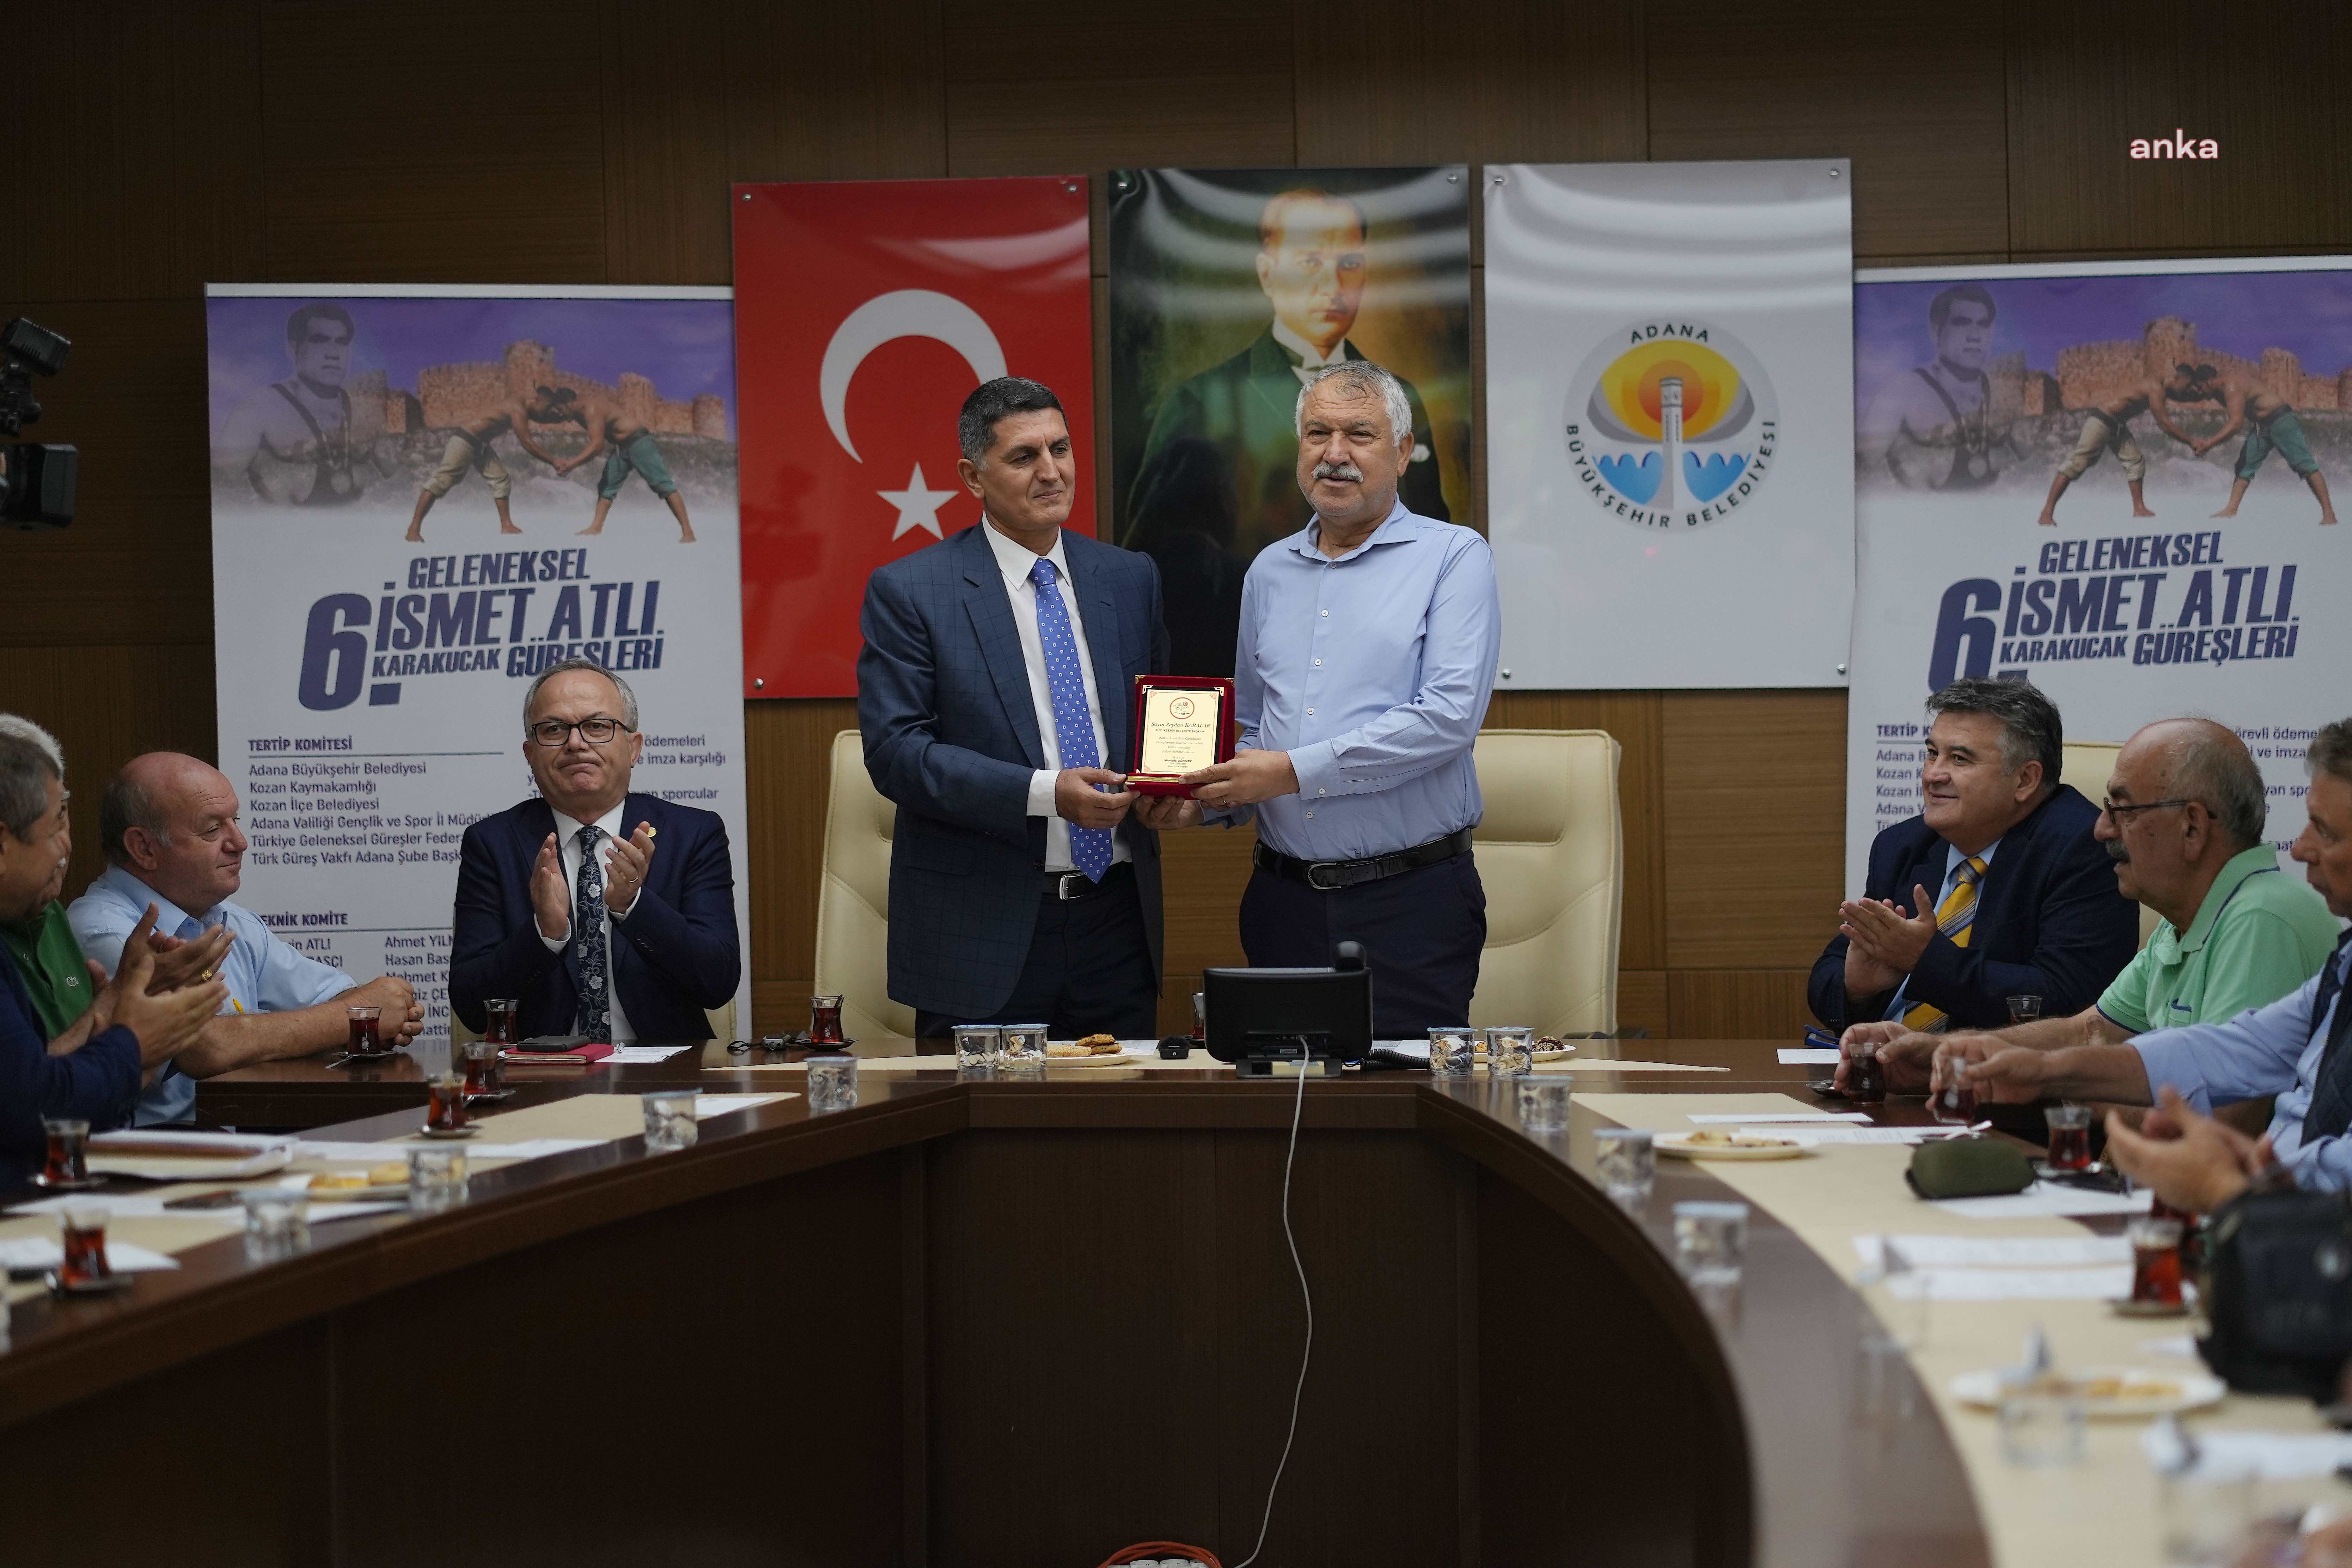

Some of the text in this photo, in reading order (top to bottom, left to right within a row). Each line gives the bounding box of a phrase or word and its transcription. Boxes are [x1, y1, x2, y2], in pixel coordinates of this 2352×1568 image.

[1631, 324, 1708, 343] ADANA
[2039, 531, 2223, 574] GELENEKSEL
[407, 548, 591, 590] GELENEKSEL
[2003, 565, 2297, 637] İSMET ATLI
[375, 580, 660, 652] İSMET ATLI
[1999, 616, 2299, 666] KARAKUCAK GÜREŞLERİ
[372, 648, 500, 678] KARAKUCAK
[1876, 722, 1918, 737] TERTİP
[249, 736, 352, 751] TERTİP KOMİTESİ
[645, 735, 705, 748] ödemeleri
[648, 752, 676, 765] imza
[680, 751, 726, 767] karşılığı
[1876, 750, 1914, 762] Adana
[2257, 748, 2271, 758] ve
[2275, 745, 2306, 758] imza
[250, 762, 427, 777] Adana Büyükşehir Belediyesi
[1876, 767, 1912, 779] Kozan
[250, 780, 377, 795] Kozan Kaymakamlığı
[662, 787, 719, 801] sporcular
[1876, 785, 1912, 797] Kozan
[251, 796, 379, 813] Kozan İlçe Belediyesi
[1875, 802, 1913, 815] Adana
[251, 817, 289, 830] Adana
[294, 815, 334, 830] Valiliği
[338, 815, 384, 829] Gençlik
[387, 818, 402, 826] ve
[405, 816, 433, 829] Spor
[437, 811, 444, 826] İl
[251, 831, 464, 848] Türkiye Geleneksel Güreşler Feder
[252, 849, 462, 867] Türk Güreş Vakfı Adana Şube Başk
[261, 910, 348, 926] EKNİK KOMİTE
[306, 938, 331, 950] ATLI
[385, 936, 426, 948] Ahmet
[386, 953, 450, 965] Hasan Bas
